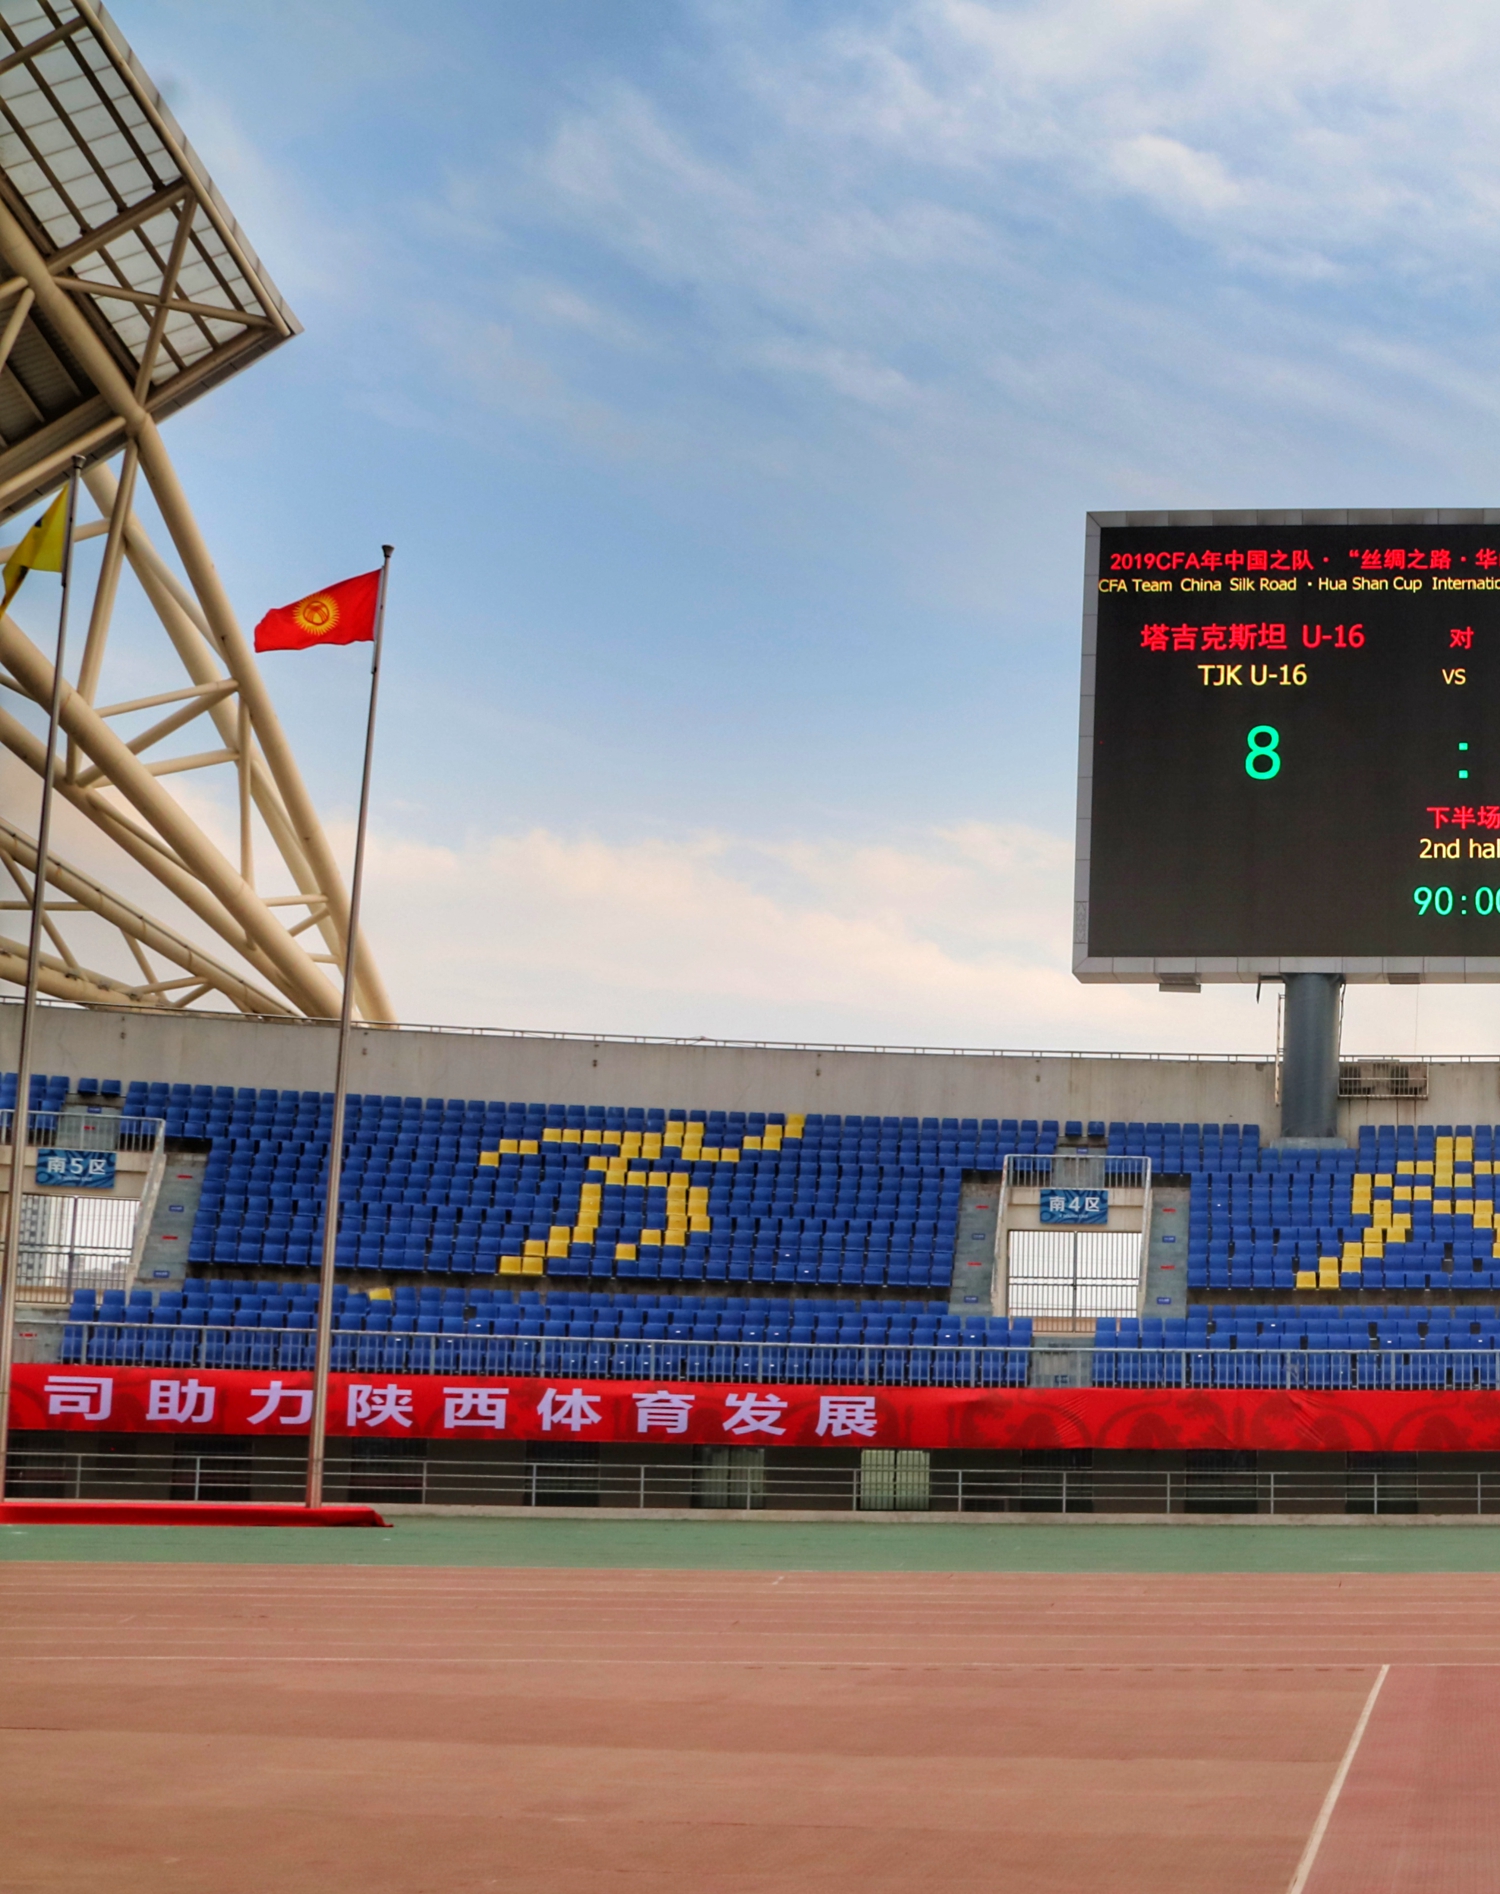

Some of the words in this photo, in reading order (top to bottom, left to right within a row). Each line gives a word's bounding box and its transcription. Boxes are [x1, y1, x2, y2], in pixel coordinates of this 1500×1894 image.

[1098, 578, 1128, 593] CFA
[1131, 578, 1173, 593] Team
[1180, 577, 1222, 592] China
[1229, 576, 1256, 592] Silk
[1259, 576, 1297, 592] Road
[1318, 577, 1348, 591] Hua
[1351, 576, 1389, 591] Shan
[1392, 576, 1423, 594] Cup
[1140, 621, 1289, 652] 塔吉克斯坦
[1301, 623, 1366, 649] U-16
[1449, 625, 1475, 650] 对
[1197, 664, 1243, 687] TJK
[1250, 663, 1308, 686] U-16
[1245, 725, 1281, 780] 8
[1419, 837, 1461, 860] 2nd
[47, 1156, 107, 1175] 南5区
[1049, 1196, 1101, 1212] 南4区
[43, 1375, 878, 1438] 司助力陕西体育发展
